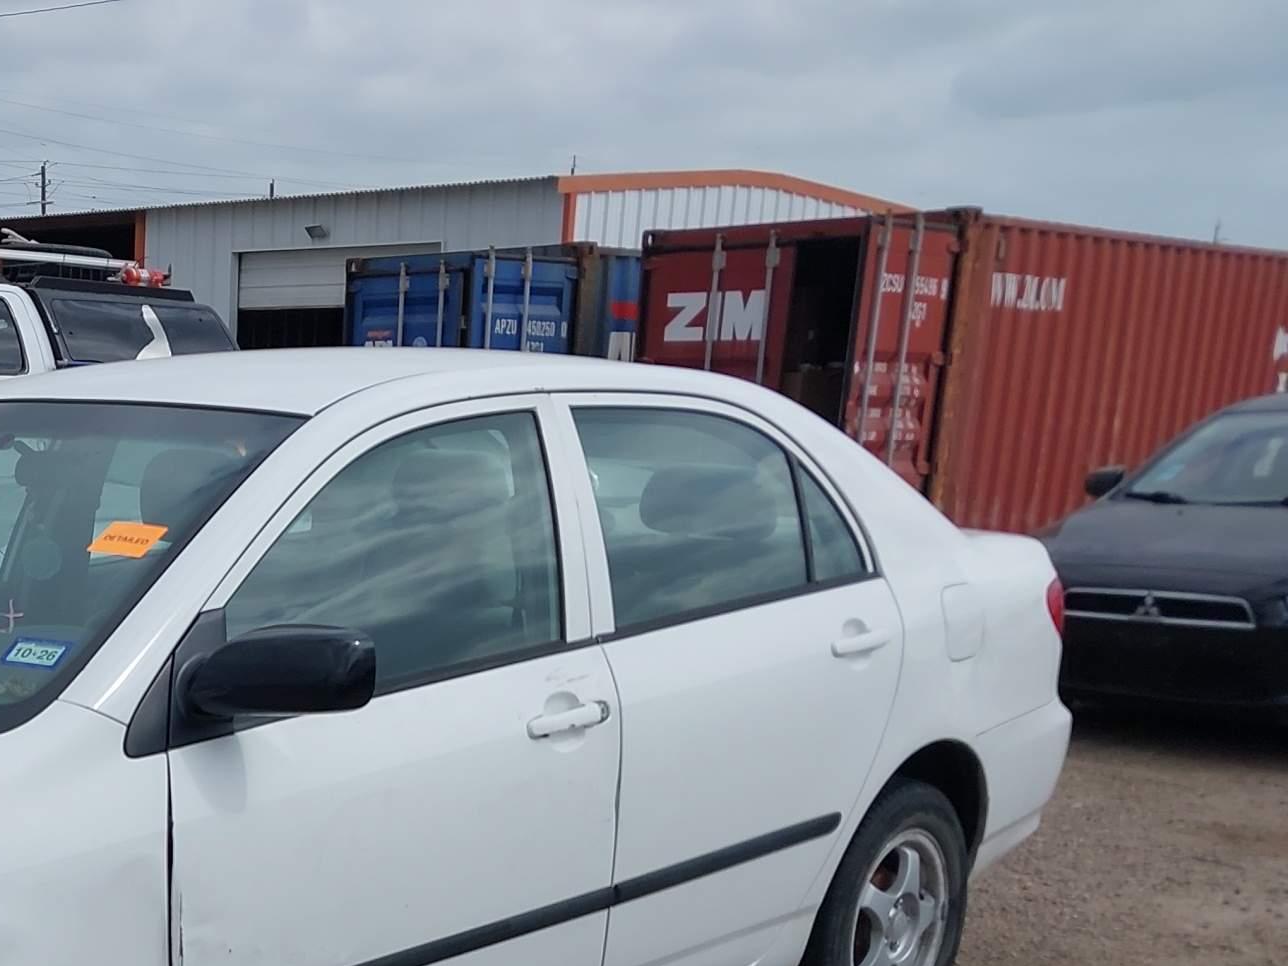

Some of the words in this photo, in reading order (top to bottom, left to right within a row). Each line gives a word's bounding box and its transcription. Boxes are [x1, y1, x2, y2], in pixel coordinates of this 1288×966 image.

[664, 289, 766, 342] ZIM
[495, 318, 517, 335] APZU
[103, 535, 150, 545] DETAILED
